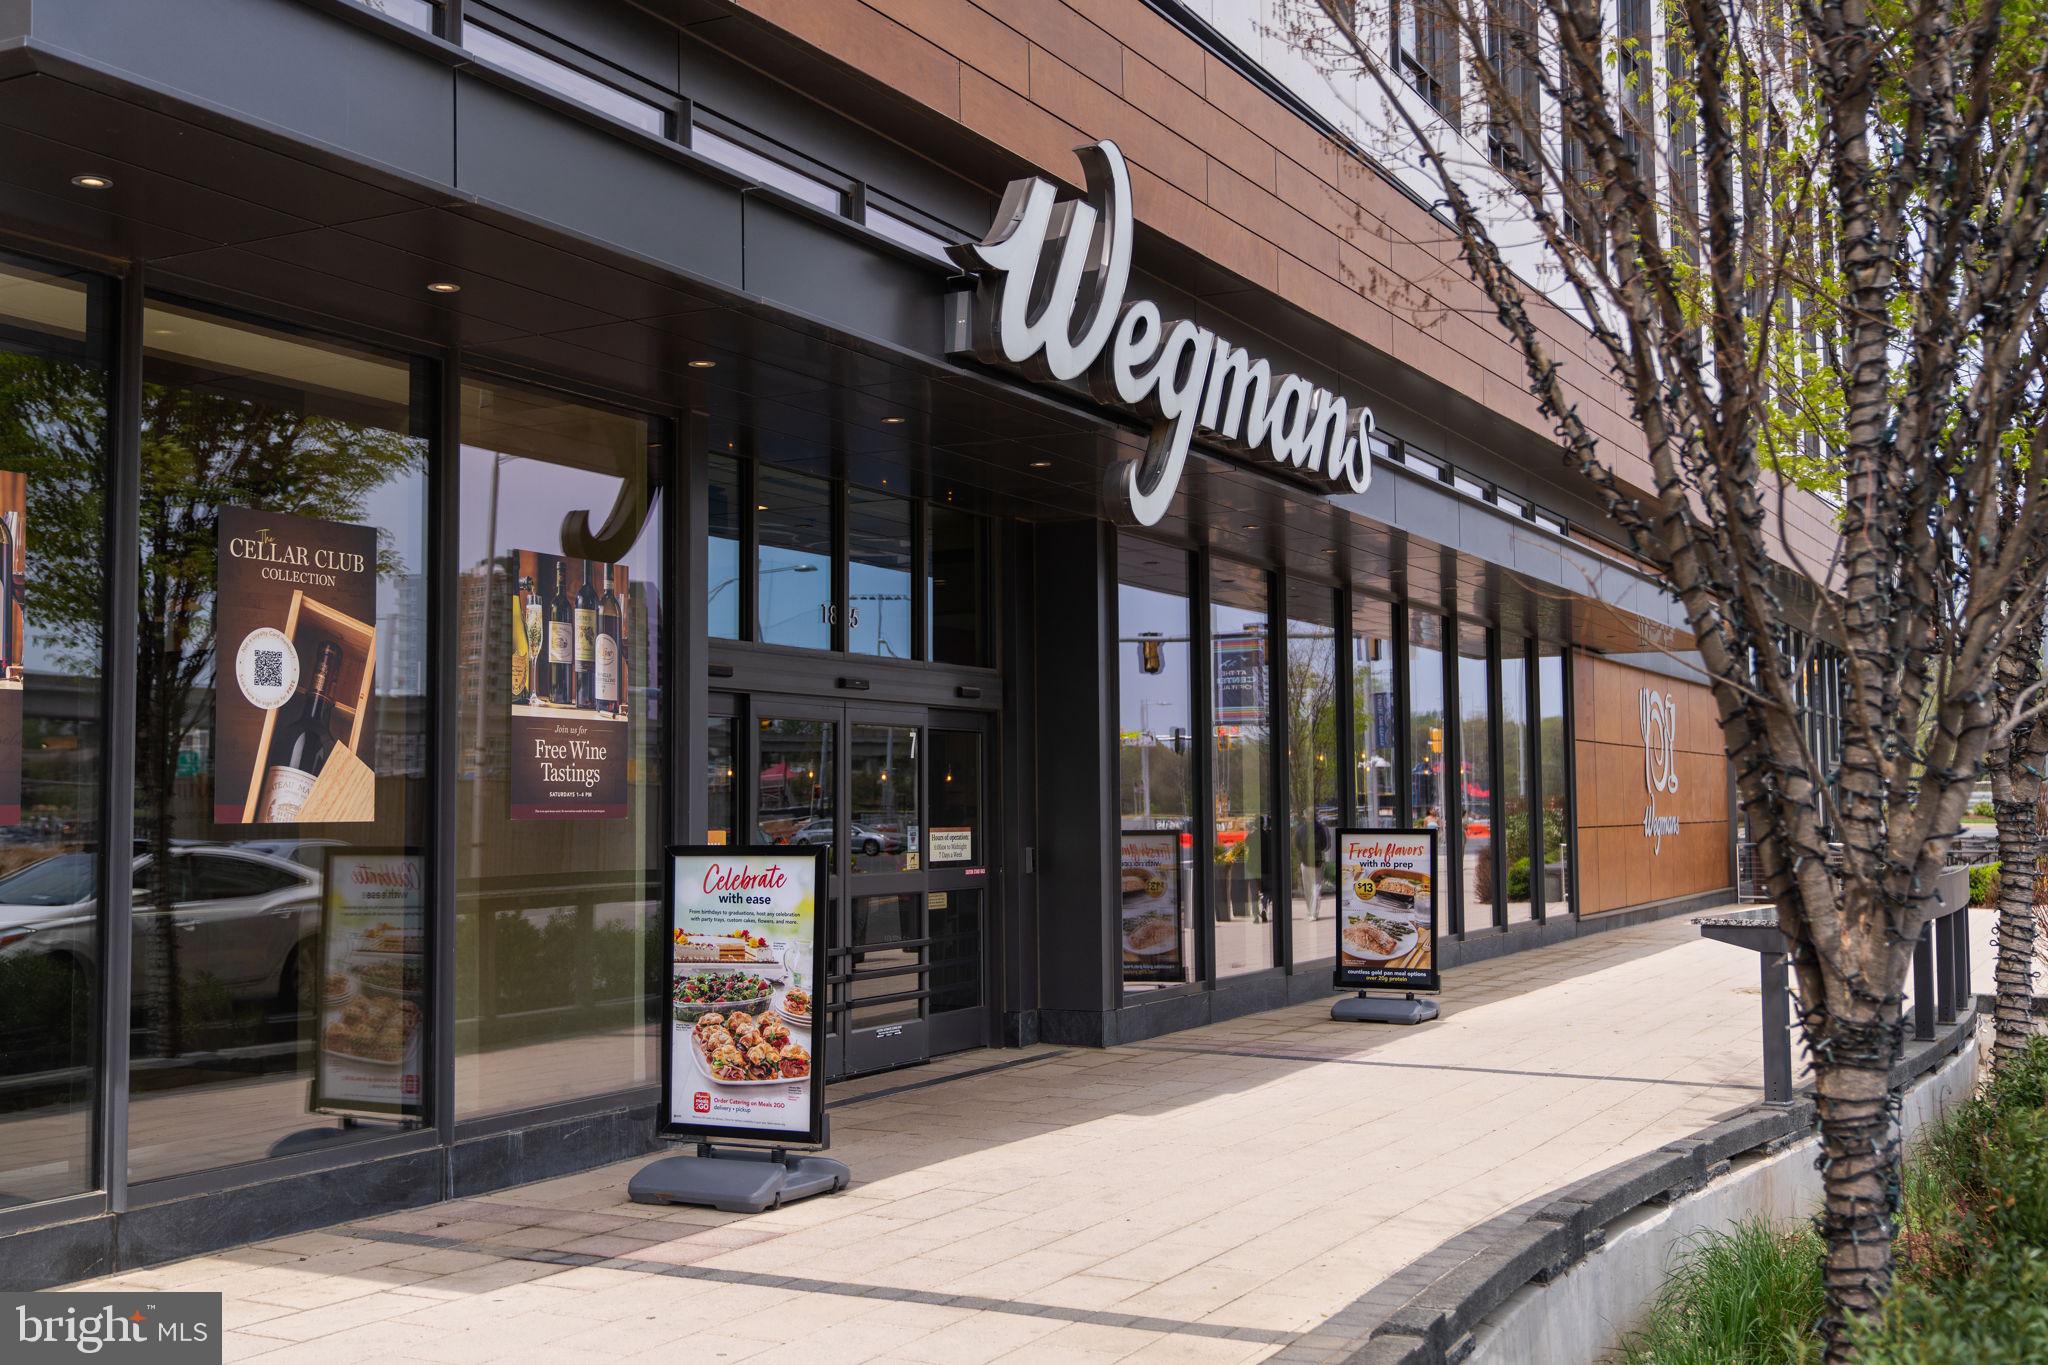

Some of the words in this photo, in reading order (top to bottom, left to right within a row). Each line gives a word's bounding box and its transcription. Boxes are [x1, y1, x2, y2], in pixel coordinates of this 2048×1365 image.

[946, 139, 1375, 526] Wegmans
[255, 528, 276, 544] The
[229, 537, 310, 566] CELLAR
[314, 549, 365, 573] CLUB
[261, 567, 336, 587] COLLECTION
[555, 725, 569, 734] Join
[577, 725, 588, 737] for
[534, 739, 567, 759] Free
[569, 740, 607, 760] Wine
[540, 762, 601, 788] Tastings
[1643, 798, 1680, 856] Wegmans
[1348, 842, 1382, 860] Fresh
[1384, 842, 1424, 863] flavors
[1360, 859, 1378, 868] with
[1393, 861, 1414, 870] prep
[703, 863, 787, 895] Celebrate
[1357, 882, 1373, 893] $13
[719, 892, 743, 904] with
[745, 895, 772, 905] ease
[713, 1104, 731, 1112] delivery
[729, 1098, 750, 1106] Catering
